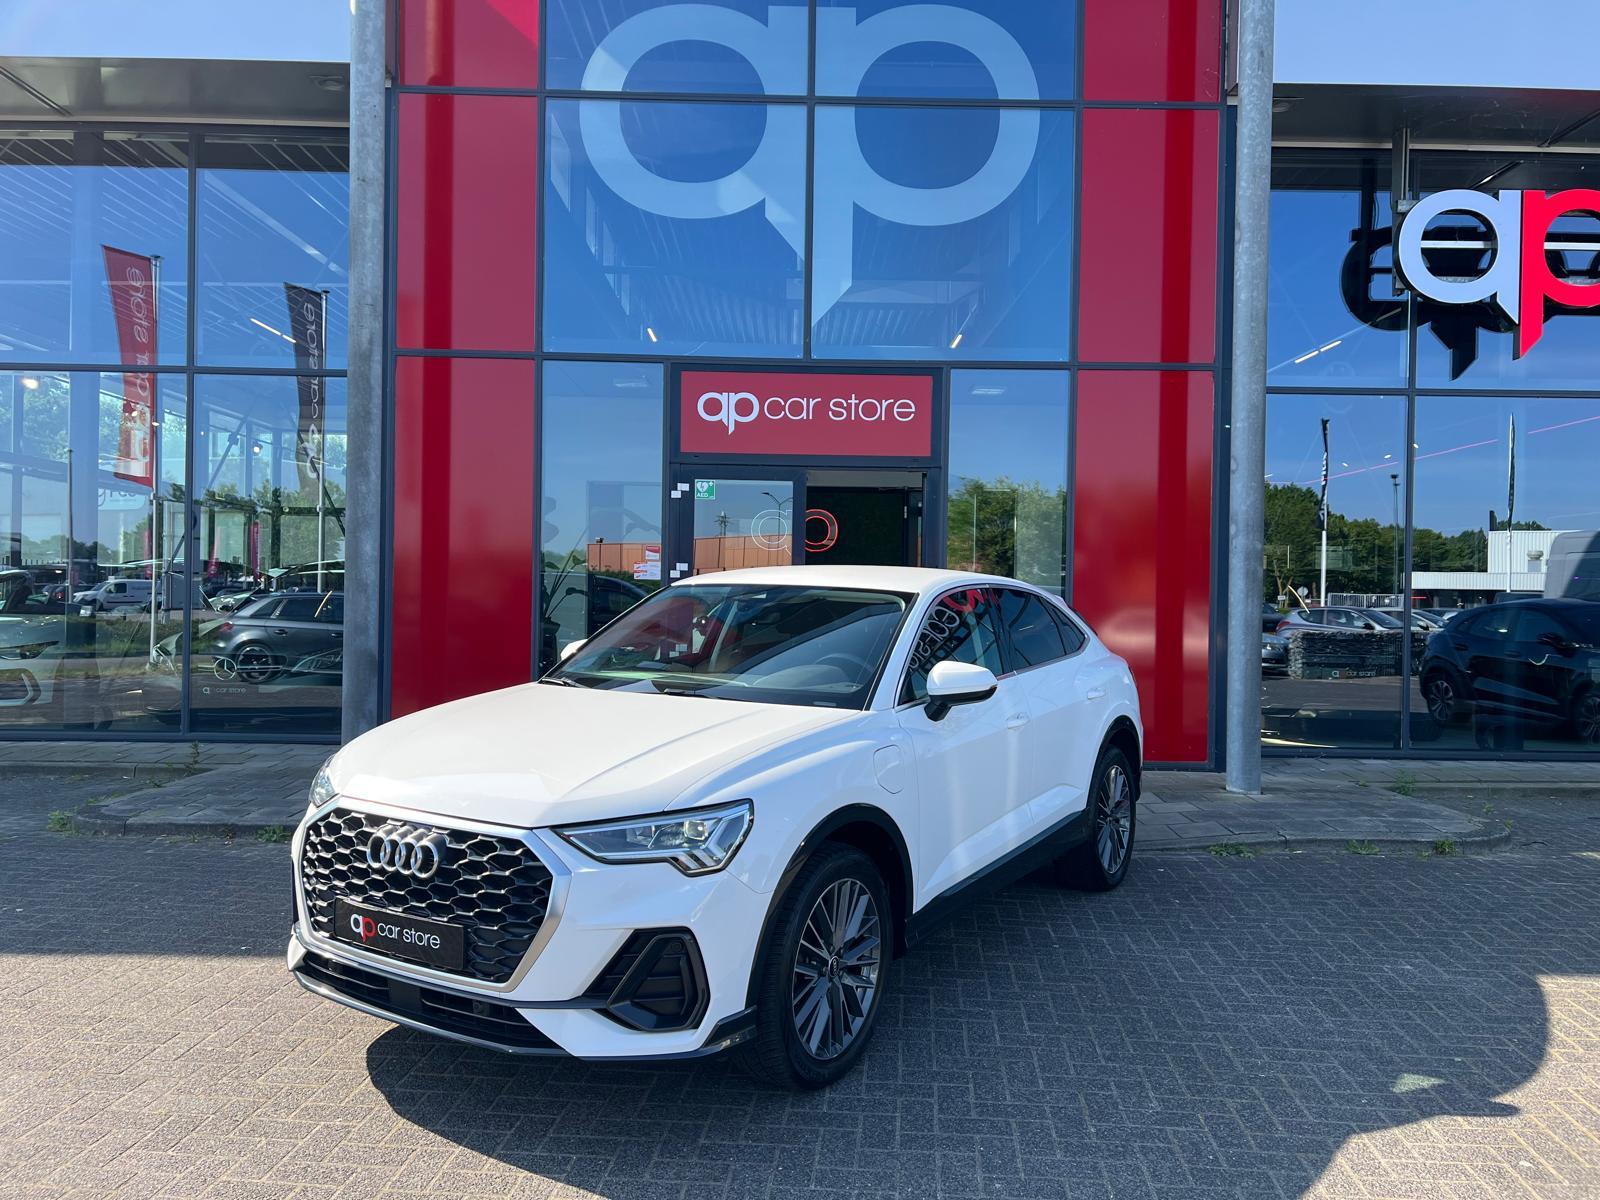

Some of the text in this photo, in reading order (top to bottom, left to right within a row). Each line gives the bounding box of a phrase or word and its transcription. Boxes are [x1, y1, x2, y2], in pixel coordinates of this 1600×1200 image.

[579, 3, 1041, 328] ap
[696, 391, 916, 435] ap car store
[350, 914, 441, 950] ap car store
